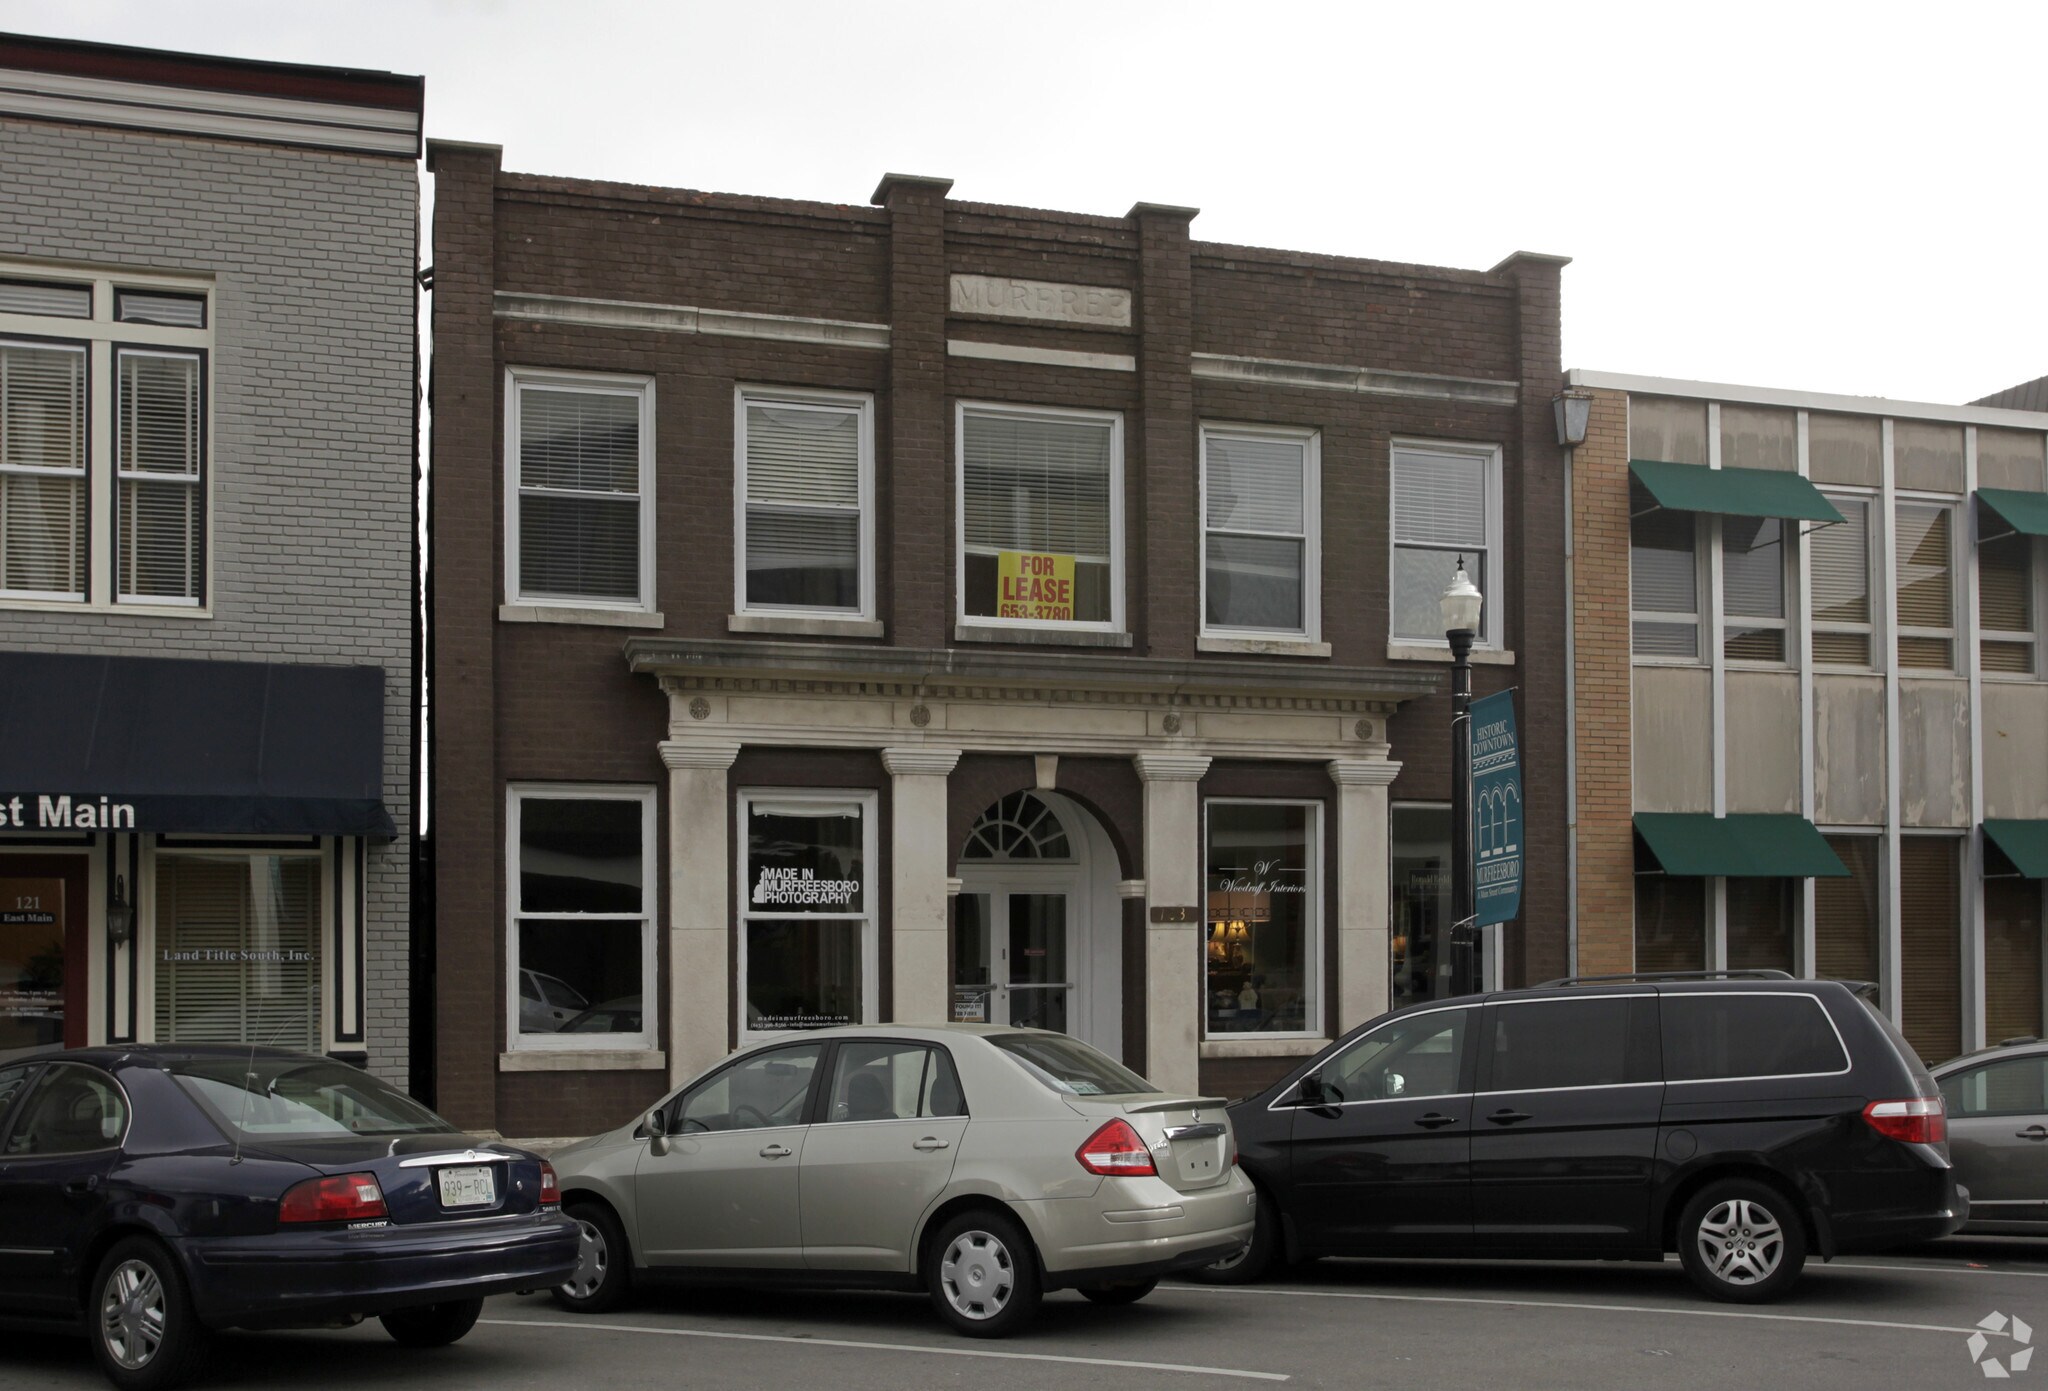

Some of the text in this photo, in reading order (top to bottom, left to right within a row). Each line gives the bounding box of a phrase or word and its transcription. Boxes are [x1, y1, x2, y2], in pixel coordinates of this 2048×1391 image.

[1021, 555, 1054, 576] FOR
[1003, 576, 1070, 603] LEASE
[1476, 719, 1507, 741] HISTORIC
[1473, 732, 1514, 756] DOWNTOWN
[38, 794, 135, 828] Main
[765, 867, 814, 880] MADE IN
[1253, 858, 1281, 875] W
[1476, 860, 1520, 884] MURFREESBORO
[765, 879, 860, 893] MURFREESBORO
[1219, 877, 1266, 896] Woodruff
[16, 896, 40, 910] 121
[765, 891, 852, 904] PHOTOGRAPHY
[3, 913, 53, 922] East Main
[163, 949, 315, 962] Land Title South, Inc.
[347, 1220, 388, 1230] MERCURY
